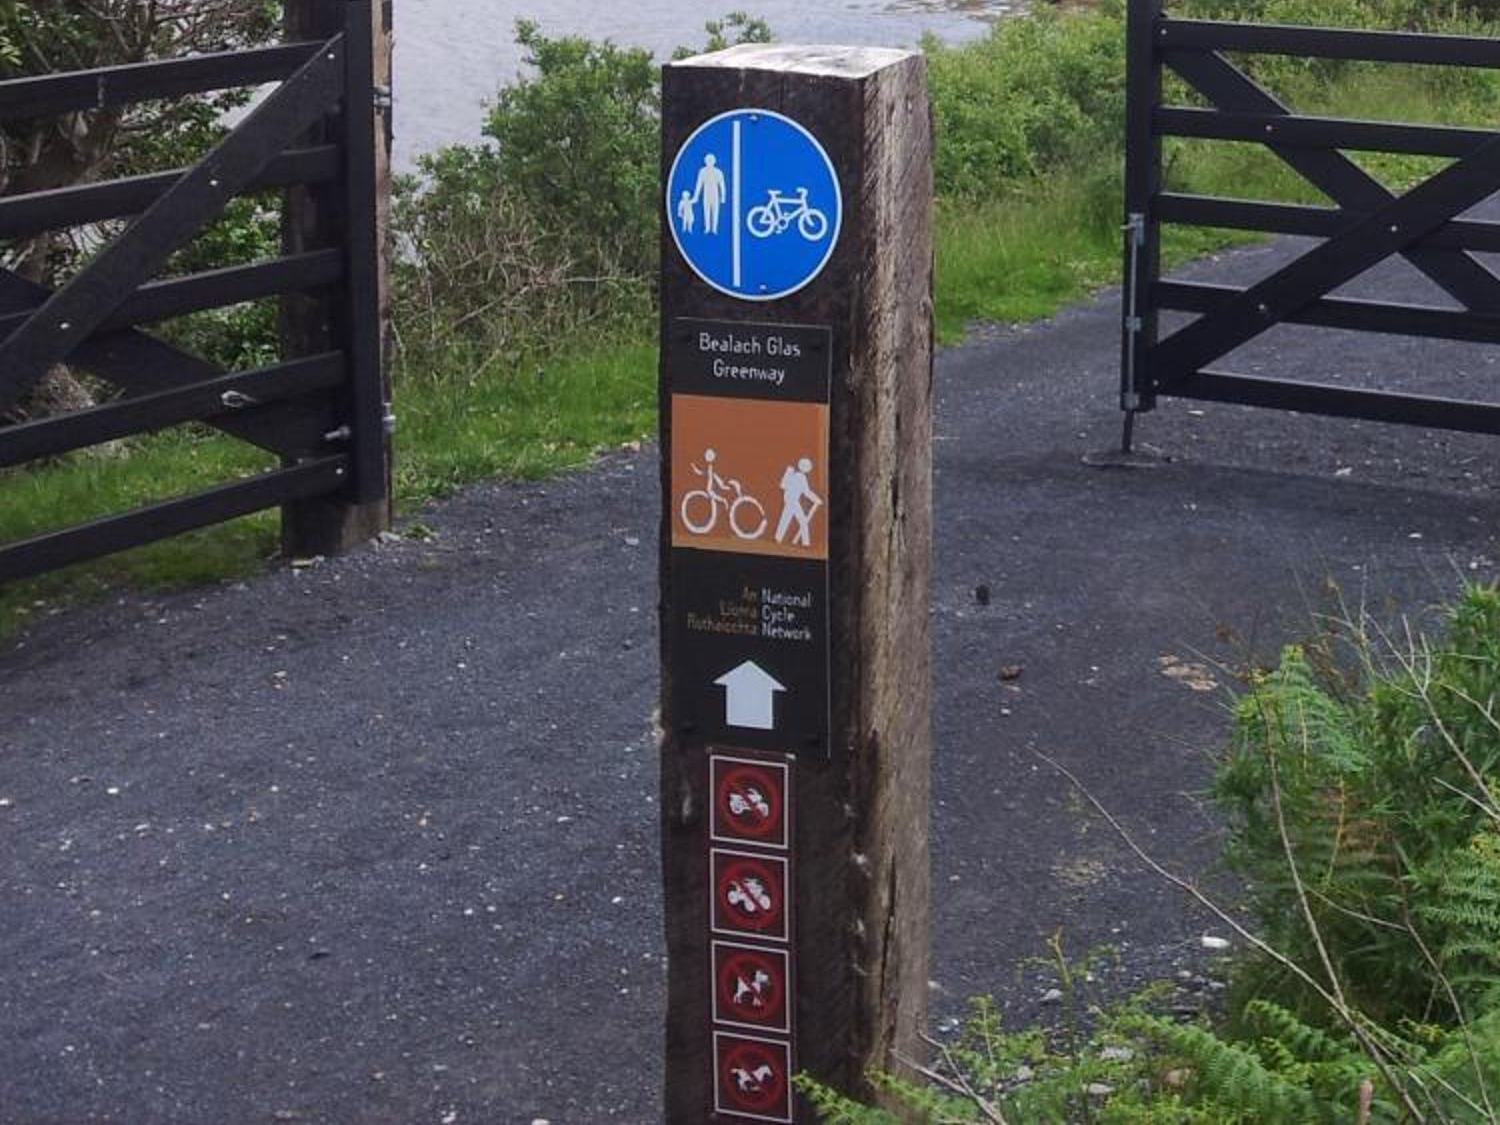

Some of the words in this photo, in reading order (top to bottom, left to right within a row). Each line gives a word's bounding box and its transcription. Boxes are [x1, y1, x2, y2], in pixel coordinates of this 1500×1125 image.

[700, 332, 761, 354] Bealach
[767, 336, 800, 356] Glas
[713, 358, 785, 385] Greenway
[761, 588, 811, 608] National
[761, 604, 795, 623] Cycle
[761, 622, 811, 640] Network
